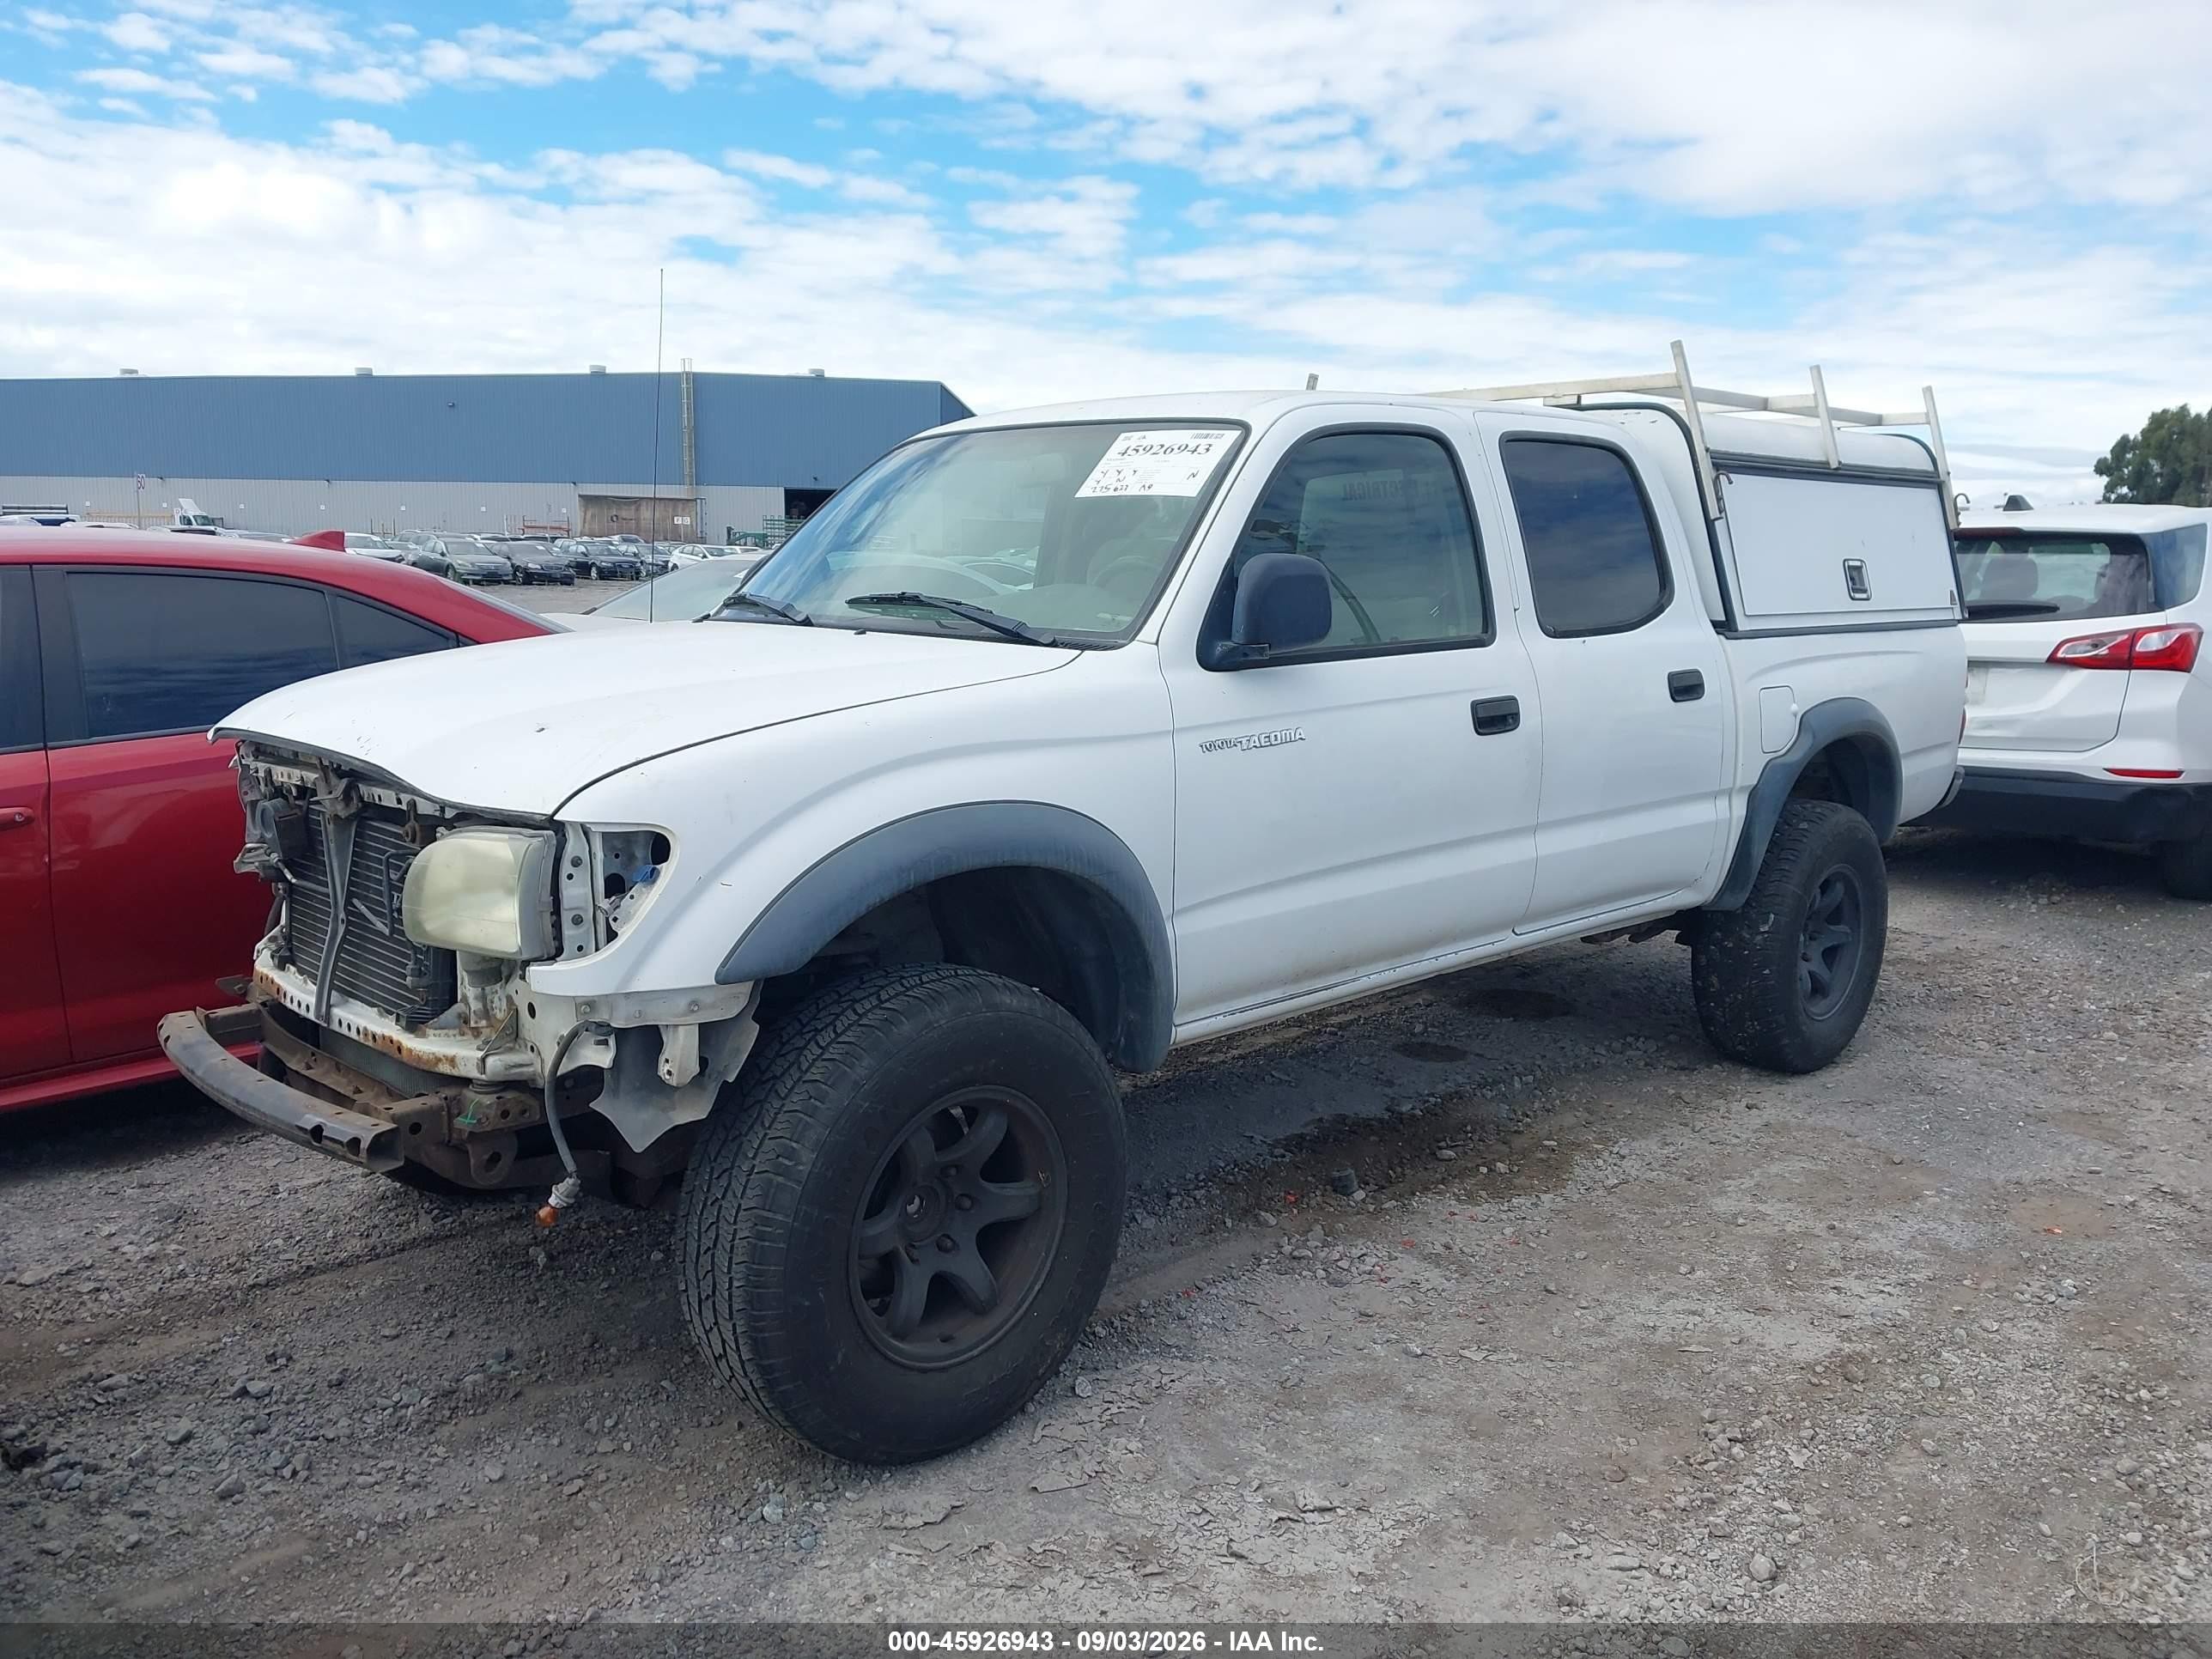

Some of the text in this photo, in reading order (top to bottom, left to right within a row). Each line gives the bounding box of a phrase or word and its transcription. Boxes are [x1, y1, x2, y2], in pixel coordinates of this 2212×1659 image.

[1118, 443, 1212, 457] 45926943
[1200, 726, 1306, 753] TOYOTA TACOMA
